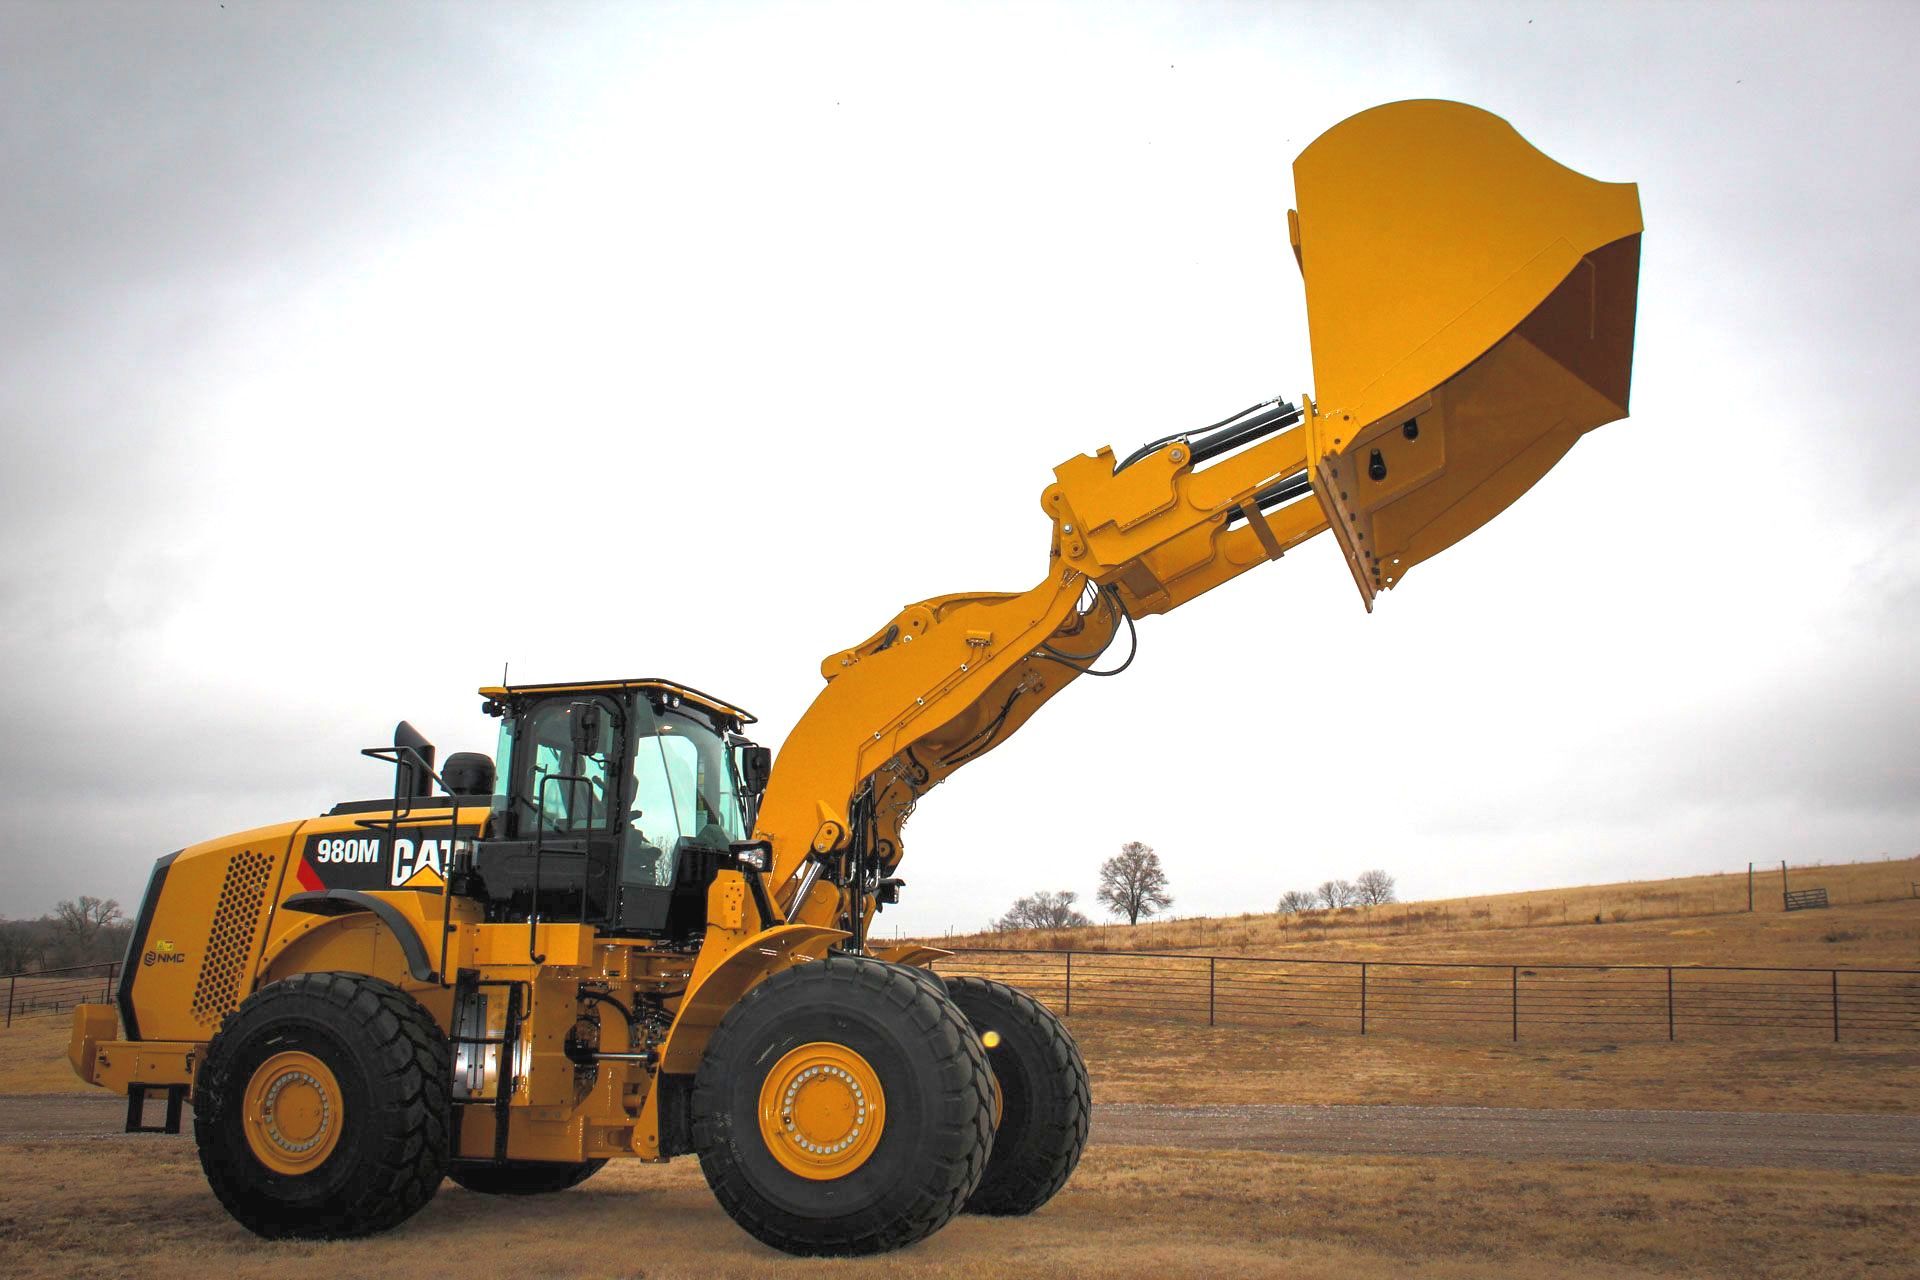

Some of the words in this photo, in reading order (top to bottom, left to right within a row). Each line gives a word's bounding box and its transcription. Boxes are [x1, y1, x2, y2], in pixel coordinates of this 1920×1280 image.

[317, 839, 380, 863] 980M
[391, 838, 465, 887] CAT
[158, 953, 185, 963] NMC
